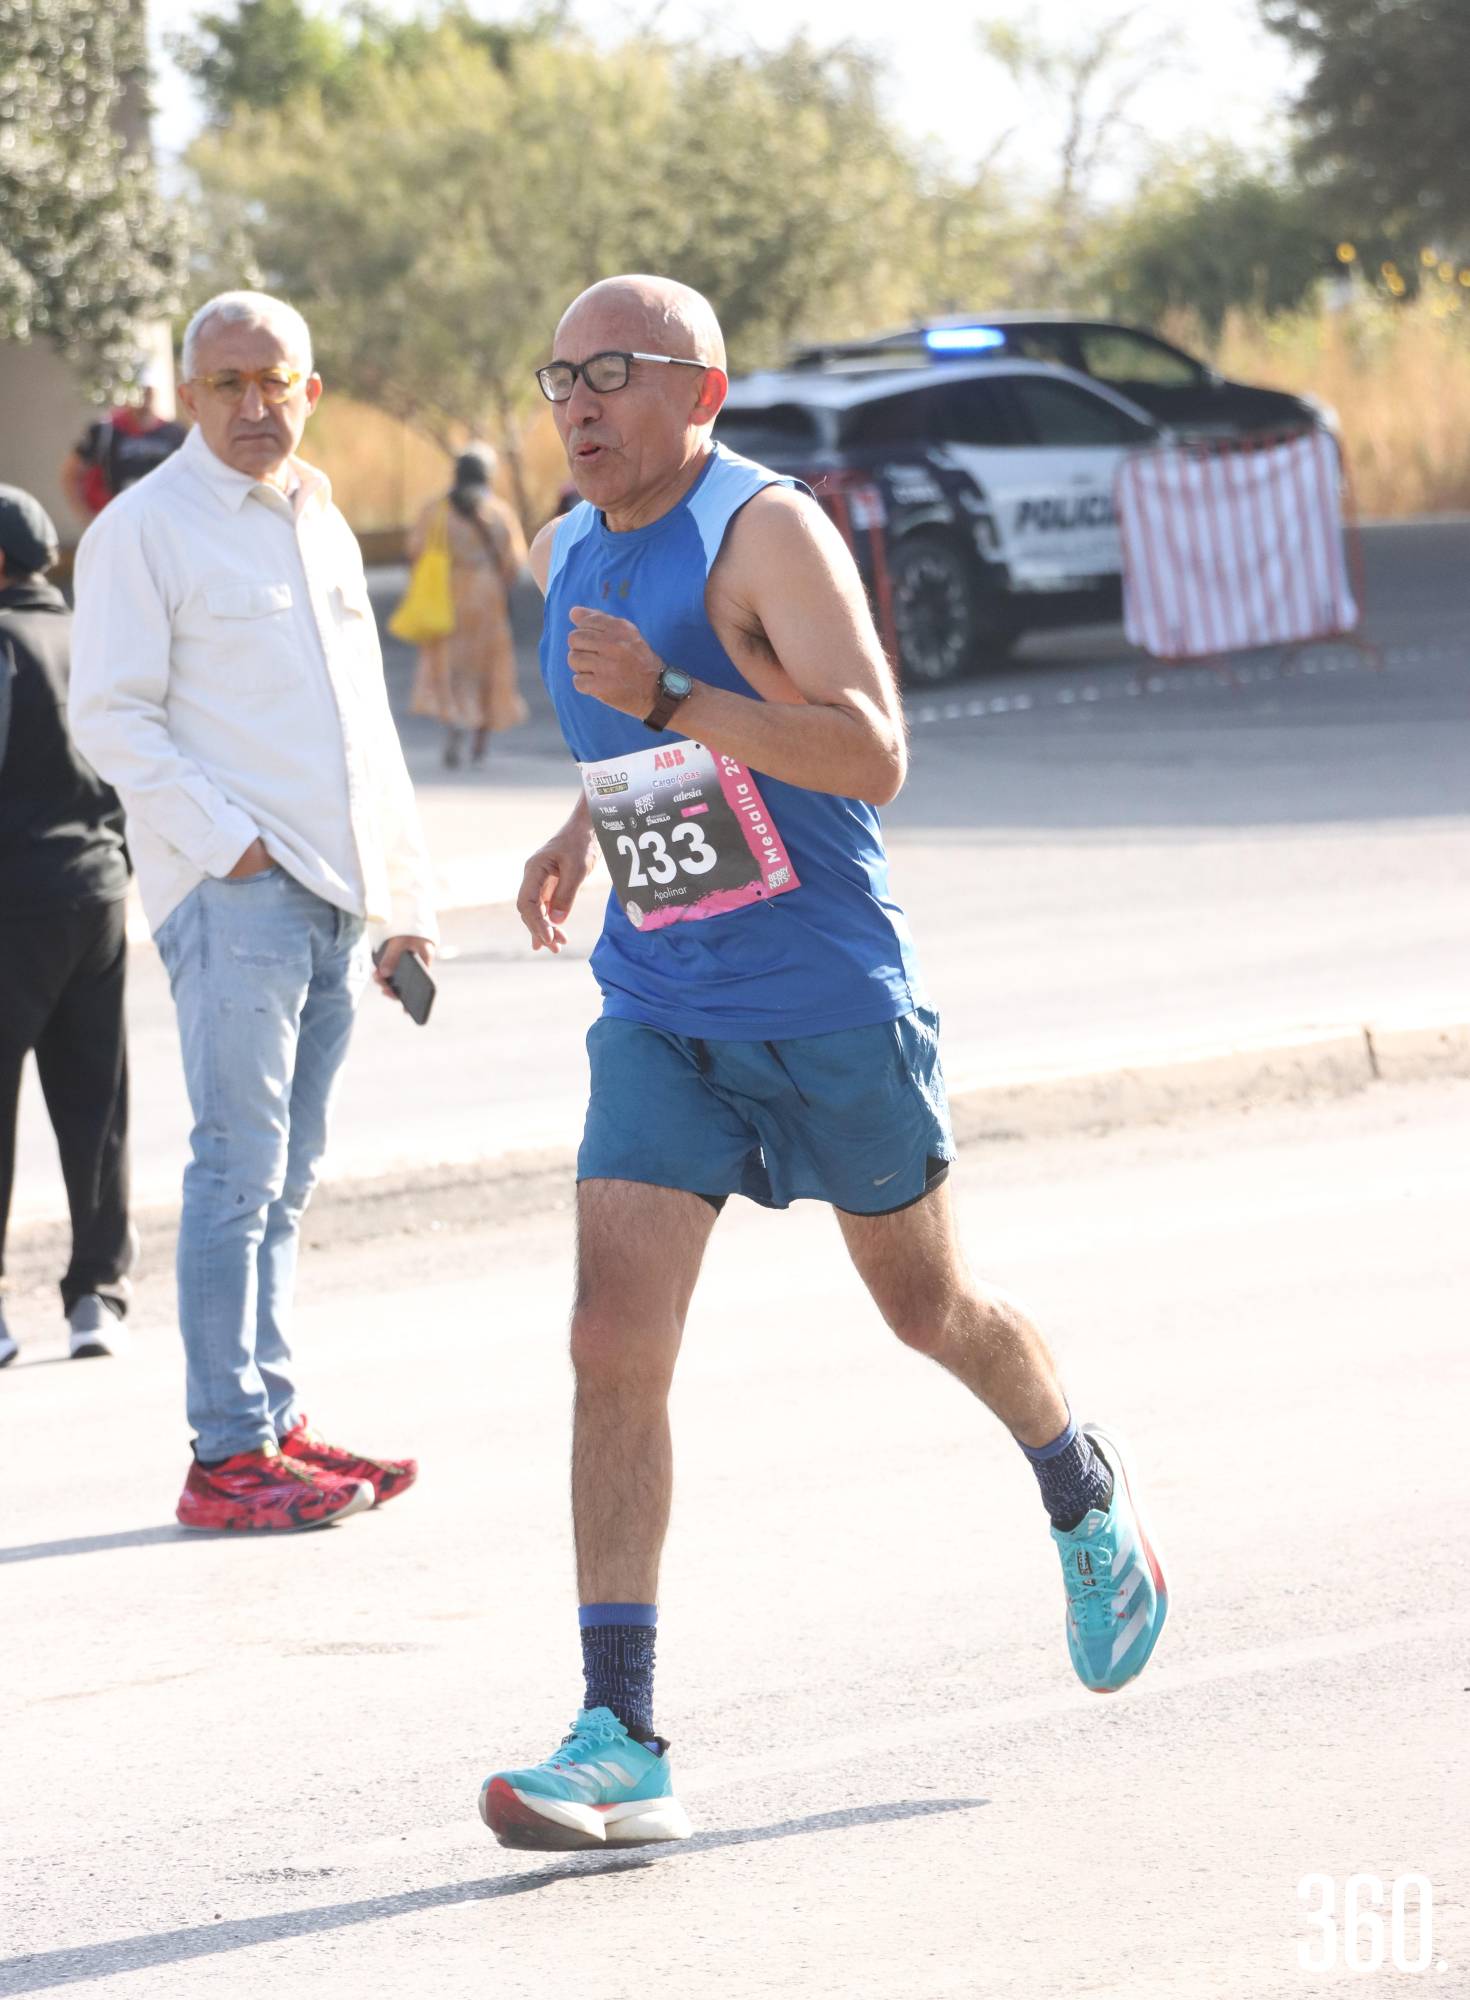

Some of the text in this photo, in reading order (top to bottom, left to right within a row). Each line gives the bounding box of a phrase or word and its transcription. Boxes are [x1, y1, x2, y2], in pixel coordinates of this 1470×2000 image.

[654, 749, 685, 771] ABB
[652, 771, 701, 788] Cargo Gas
[635, 792, 655, 808] BERRY
[635, 801, 654, 816] NUTS
[736, 783, 781, 864] Medalla
[617, 822, 717, 888] 233
[654, 887, 687, 902] Apolinar
